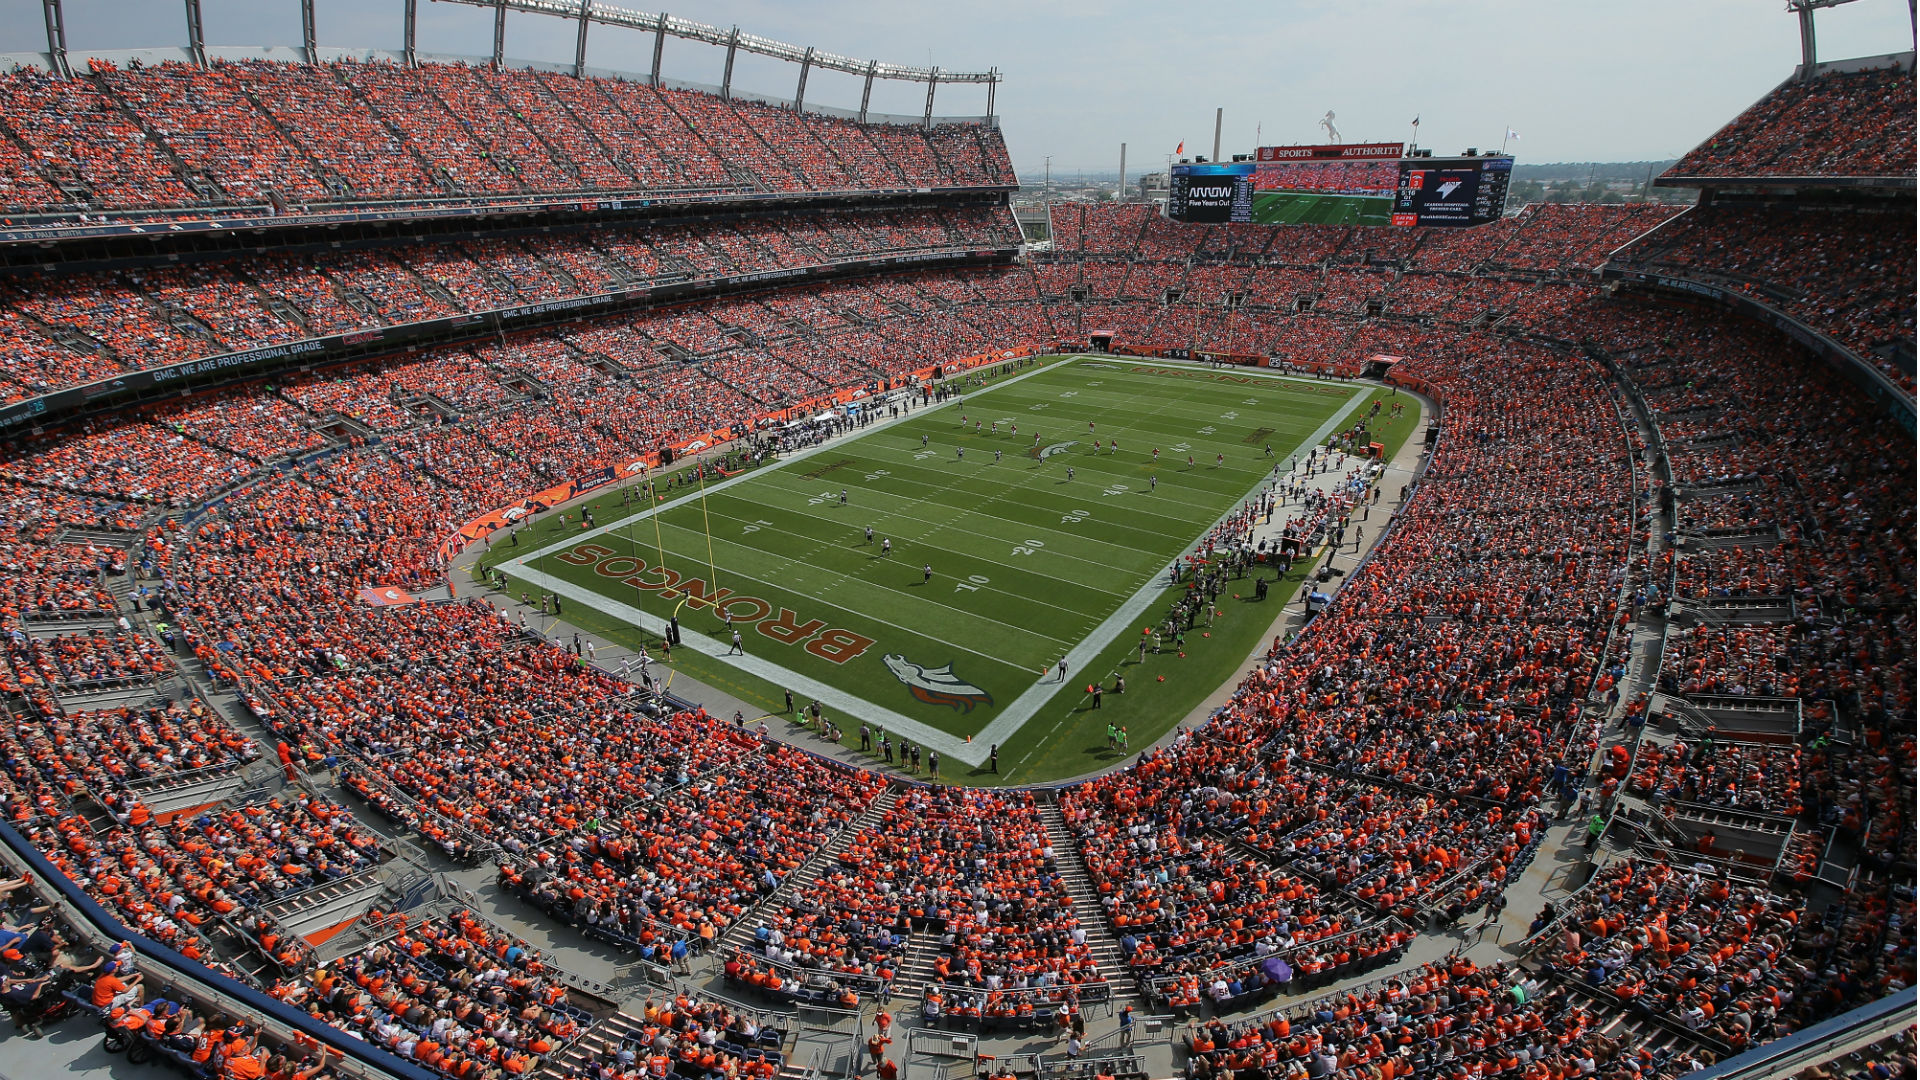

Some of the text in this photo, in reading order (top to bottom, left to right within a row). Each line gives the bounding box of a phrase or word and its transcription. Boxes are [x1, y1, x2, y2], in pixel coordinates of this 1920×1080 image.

[1278, 146, 1401, 158] SPORTS AUTHORITY
[1188, 186, 1231, 198] ARROW
[267, 217, 295, 225] CHARLEY
[296, 216, 326, 224] JOHNSON
[36, 231, 57, 239] PAUL
[57, 229, 82, 237] SMITH
[502, 295, 613, 319] GMC. WE ARE PROFESSIONAL GRADE.
[342, 331, 385, 346] GMC
[154, 369, 180, 382] GMC.
[181, 365, 197, 376] WE
[198, 361, 216, 373] ARE
[218, 348, 290, 369] PROFESSIONAL
[291, 341, 325, 354] GRADE.
[1128, 365, 1349, 395] BRONCOS
[581, 475, 612, 490] FOOTBALL
[1104, 484, 1128, 496] 40
[808, 491, 837, 505] 20
[1062, 509, 1090, 523] 30
[744, 520, 773, 532] 10
[1012, 539, 1044, 556] 20
[957, 574, 990, 592] 10
[554, 544, 877, 665] BRONCOS
[653, 1064, 663, 1074] 18
